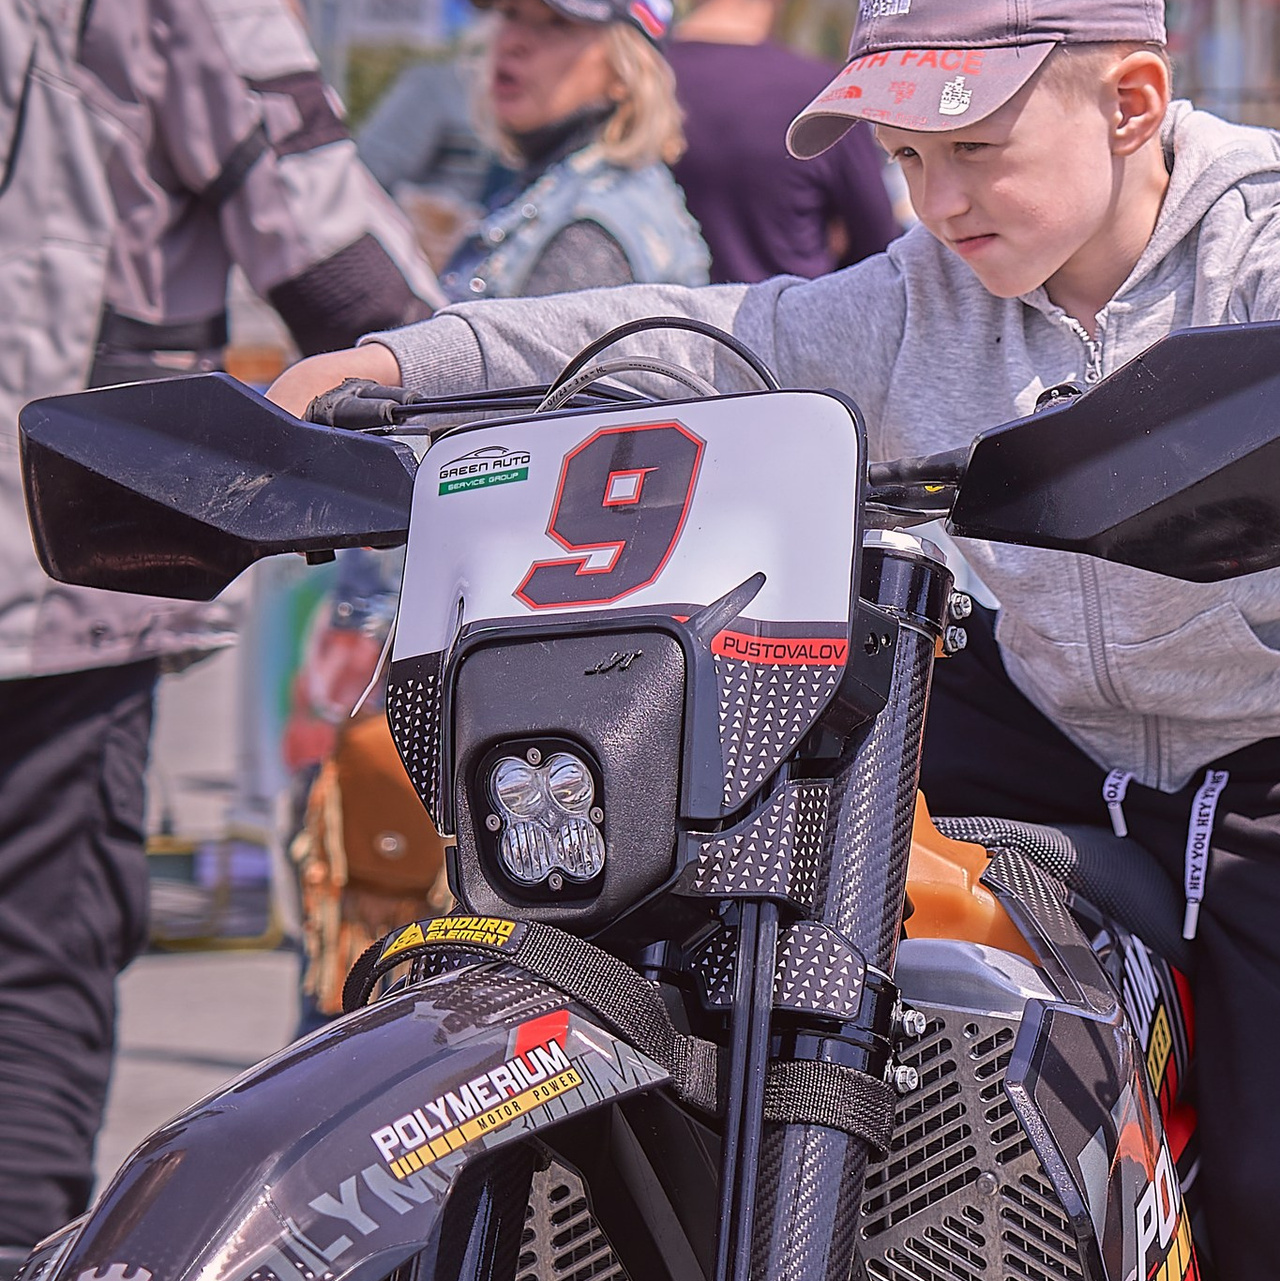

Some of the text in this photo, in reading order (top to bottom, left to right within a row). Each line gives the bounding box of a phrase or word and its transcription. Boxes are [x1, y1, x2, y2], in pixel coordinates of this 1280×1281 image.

[900, 49, 987, 76] FACE
[439, 454, 531, 480] GREEN AUTO
[447, 471, 519, 491] SERVICE GROUP
[512, 418, 708, 612] 9
[723, 636, 846, 661] PUSTOVALOV
[1198, 801, 1213, 827] HEY
[1192, 832, 1207, 860] YOU
[1189, 864, 1203, 890] HEY
[424, 930, 509, 947] ELEMENT
[426, 917, 517, 937] ENDURO
[371, 1039, 571, 1162] POLYMERIUM
[477, 1072, 578, 1131] MOTOR POWER
